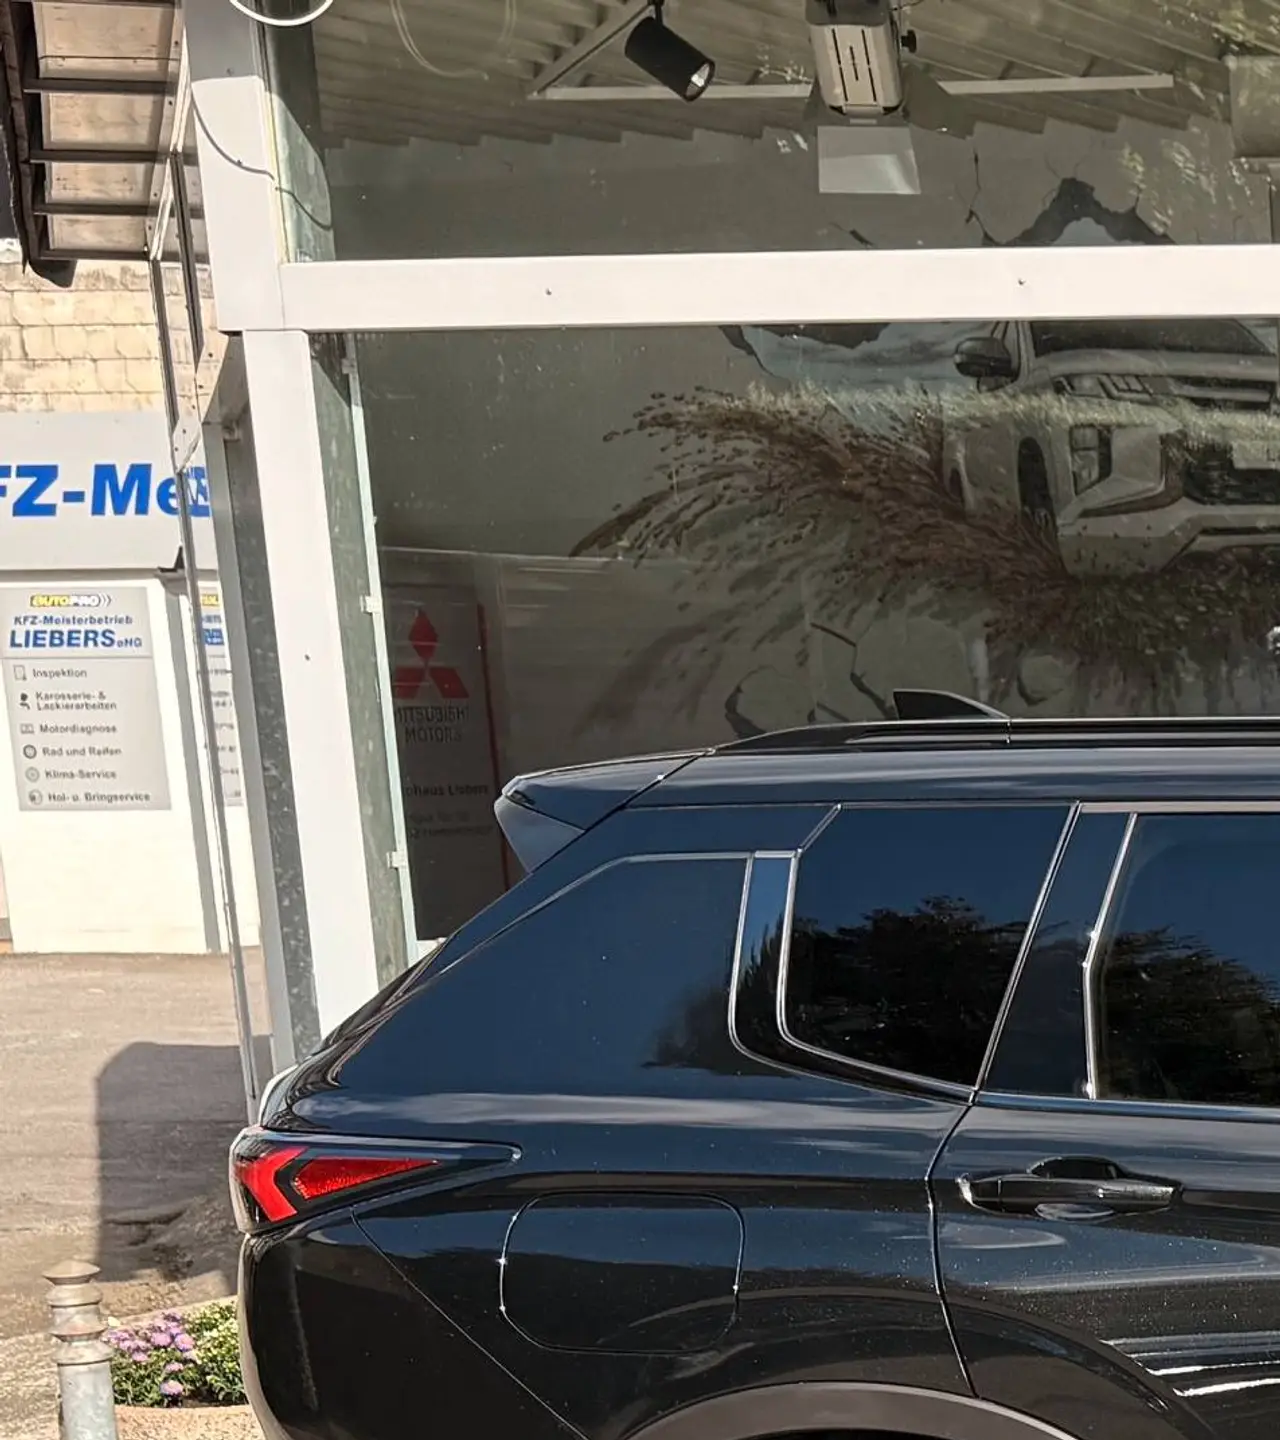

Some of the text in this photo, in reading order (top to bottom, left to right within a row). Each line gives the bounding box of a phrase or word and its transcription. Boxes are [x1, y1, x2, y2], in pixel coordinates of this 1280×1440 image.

[14, 615, 133, 626] KFZ-Meisterbetrieb
[10, 628, 116, 648] LIEBERS
[33, 668, 87, 679] Inspektion
[40, 724, 117, 736] Motordiagnose
[45, 768, 117, 780] Klima-Service
